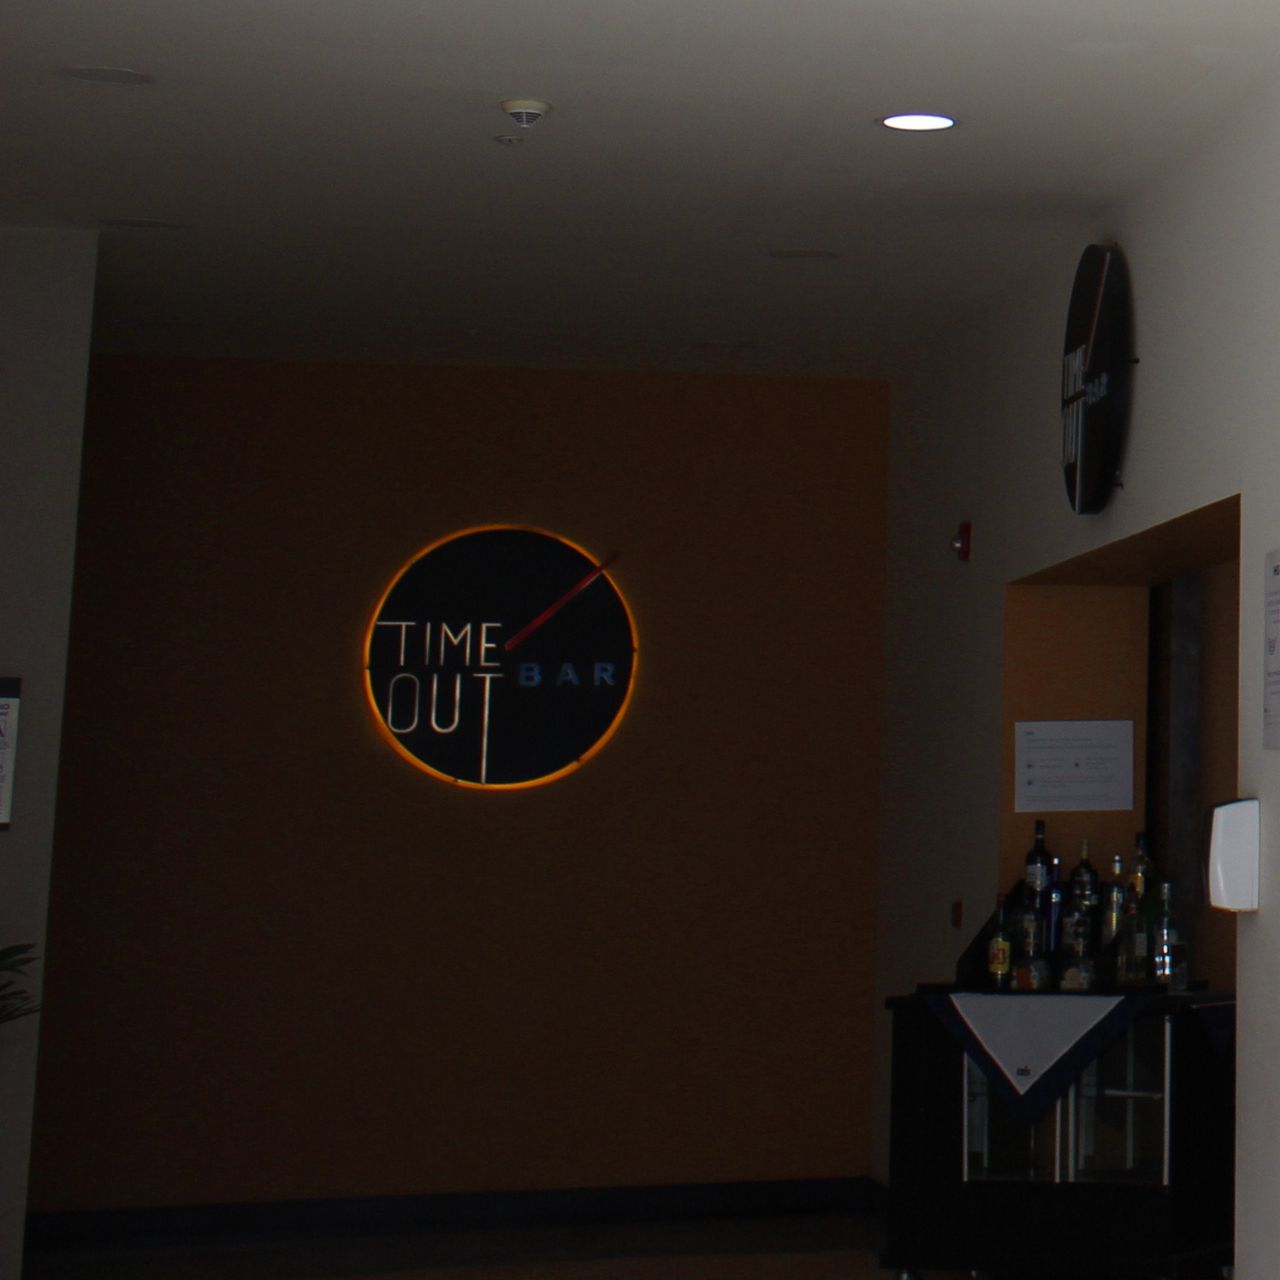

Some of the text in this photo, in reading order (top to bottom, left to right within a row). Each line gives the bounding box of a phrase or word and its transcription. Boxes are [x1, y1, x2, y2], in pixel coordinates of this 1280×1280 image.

[375, 621, 503, 667] TIME
[517, 662, 617, 687] BAR
[387, 672, 505, 785] OUT
